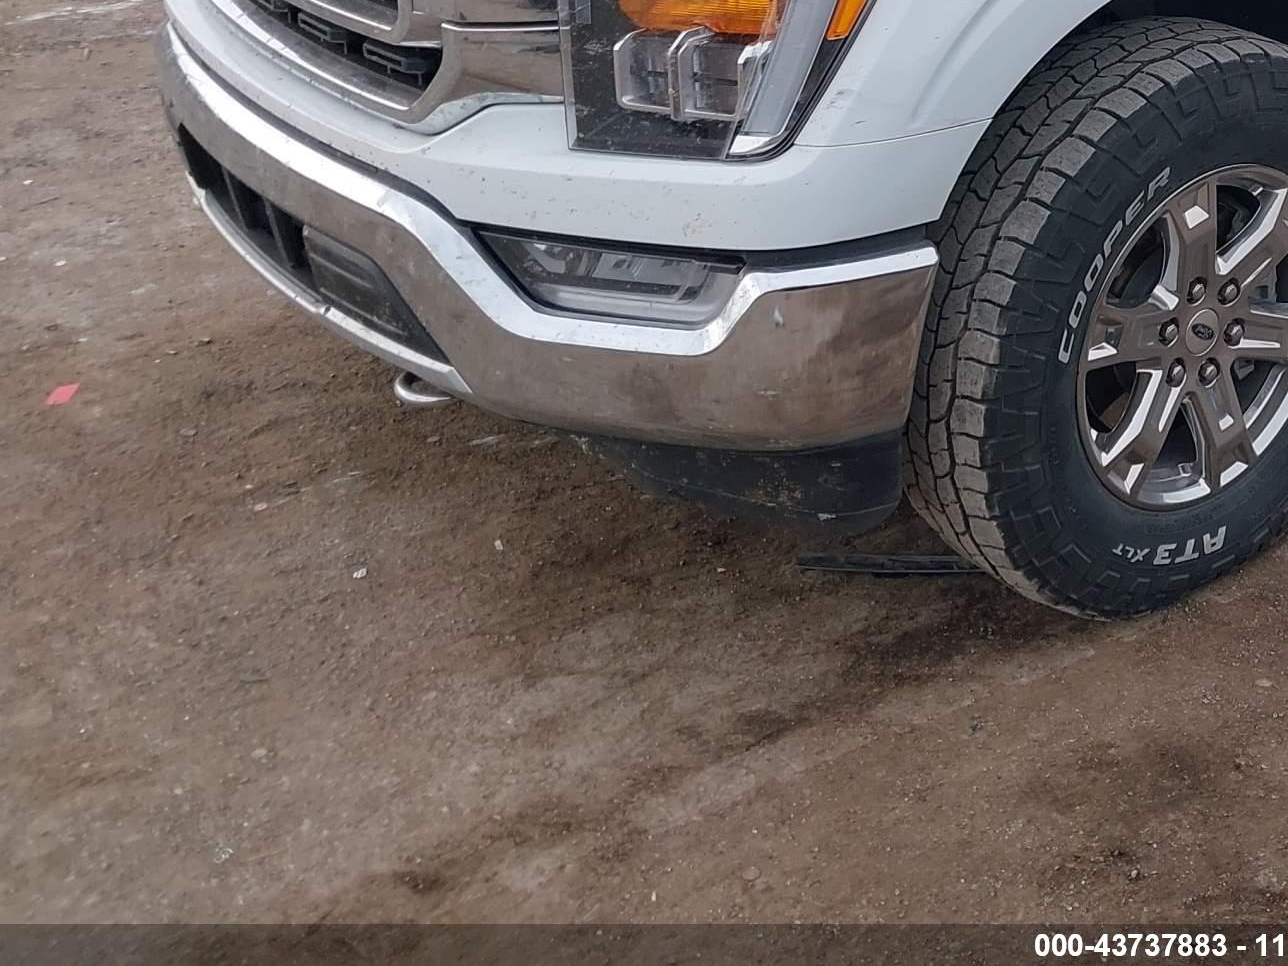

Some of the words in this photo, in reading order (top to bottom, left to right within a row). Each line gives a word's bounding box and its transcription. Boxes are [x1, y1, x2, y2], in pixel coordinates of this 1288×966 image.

[1057, 166, 1172, 365] COOPER
[1112, 543, 1151, 563] XLT
[1153, 525, 1227, 565] AT3
